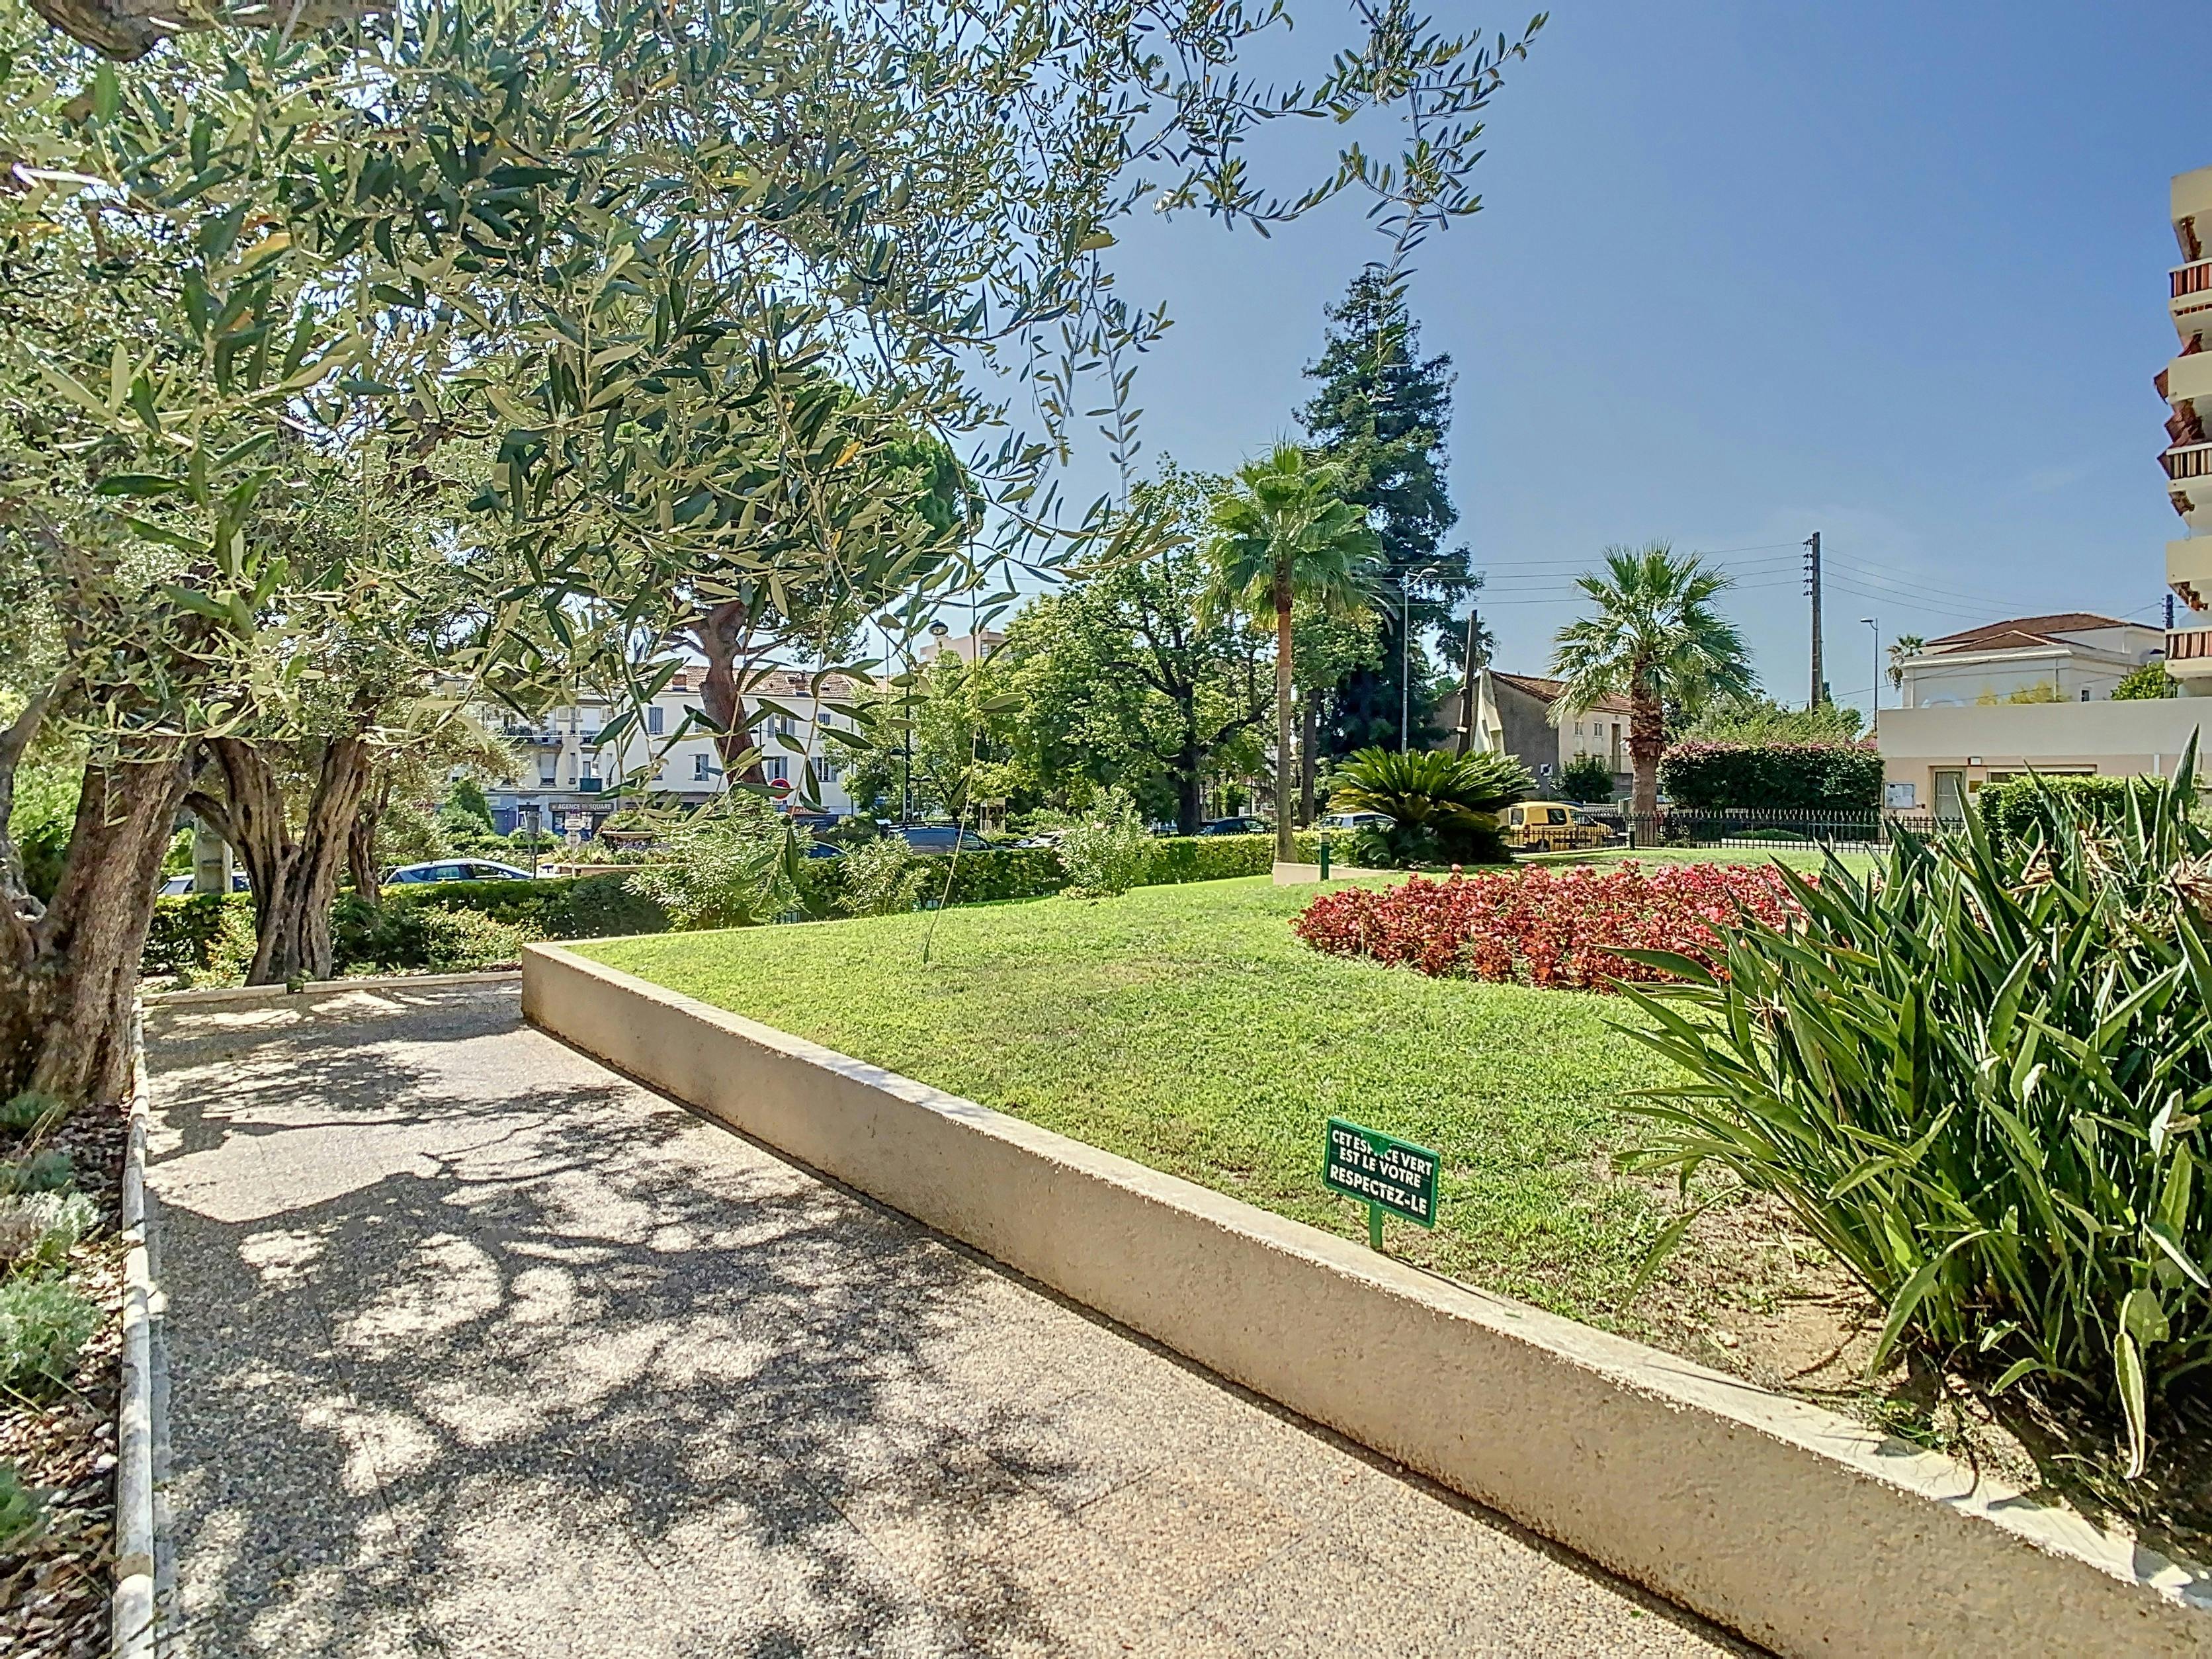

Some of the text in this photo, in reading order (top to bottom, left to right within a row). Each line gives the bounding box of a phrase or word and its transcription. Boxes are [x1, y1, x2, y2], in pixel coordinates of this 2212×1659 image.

[1332, 1130, 1433, 1176] CET ESPCE VERT
[1340, 1146, 1422, 1189] EST LE VOTRE
[1330, 1164, 1427, 1215] RESPECTEZ-LE
